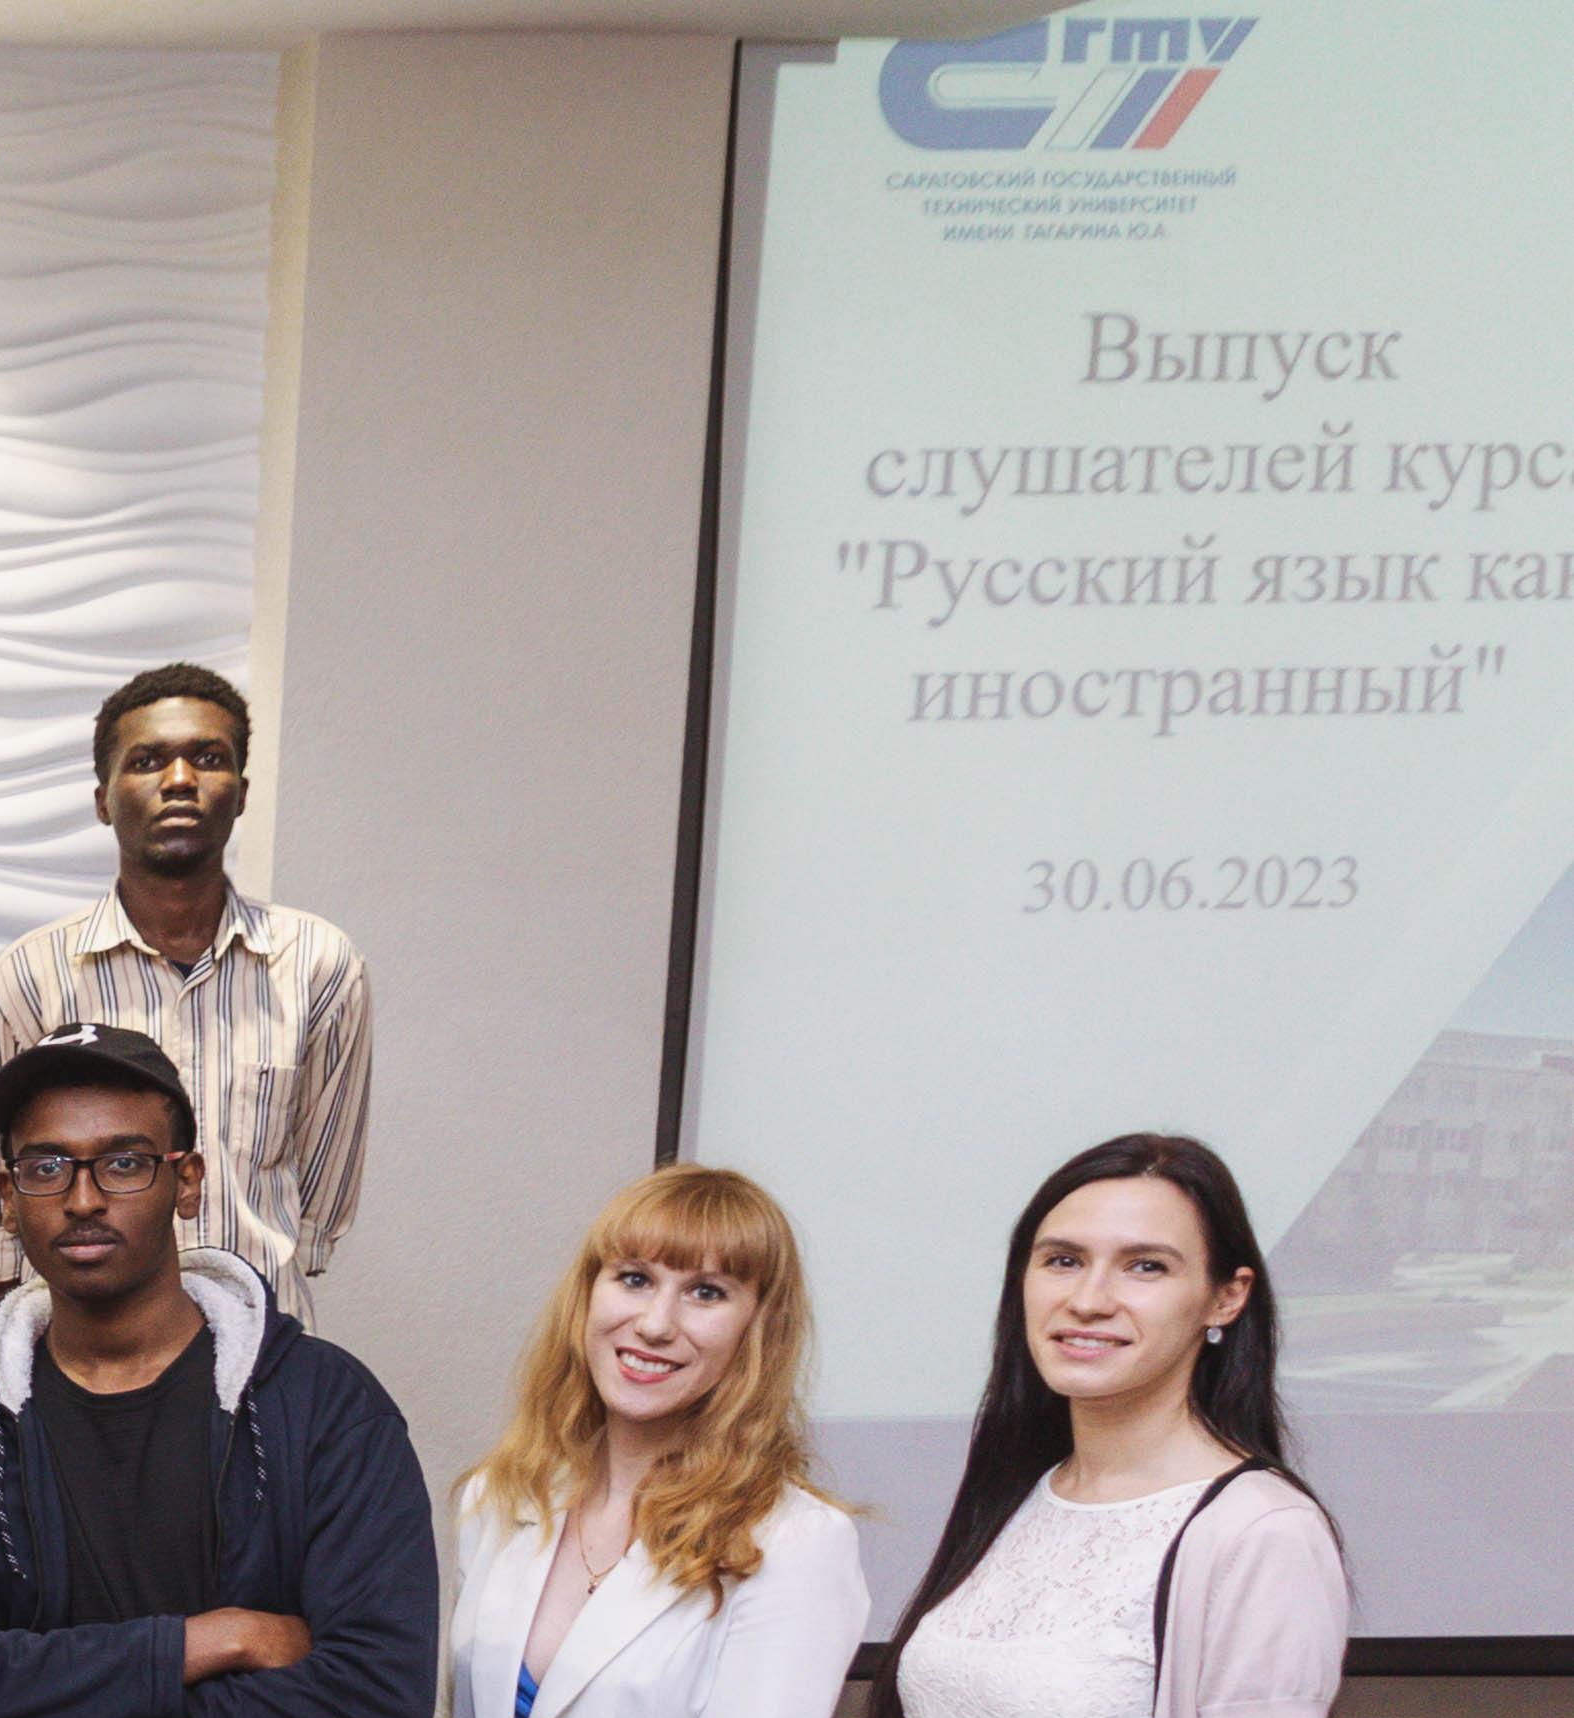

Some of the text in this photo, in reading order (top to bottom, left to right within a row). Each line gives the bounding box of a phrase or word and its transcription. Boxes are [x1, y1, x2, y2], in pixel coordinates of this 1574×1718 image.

[885, 165, 1237, 190] САРАТОВСКИЙ ГОСУДАРСТВЕННЫЙ
[923, 195, 1198, 216] ТЕХНИЧЕСКИЙ УНИВЕРСИТЕТ
[943, 223, 1014, 242] ИМЕНИ
[1024, 221, 1122, 240] ГАГАРИНА
[1080, 312, 1402, 401] Выпуск
[864, 422, 1574, 517] слушателей курс
[836, 534, 1219, 628] "Русский
[1248, 550, 1442, 604] язык
[907, 645, 1506, 738] иностранный"
[1021, 856, 1360, 915] 30.06.2023
